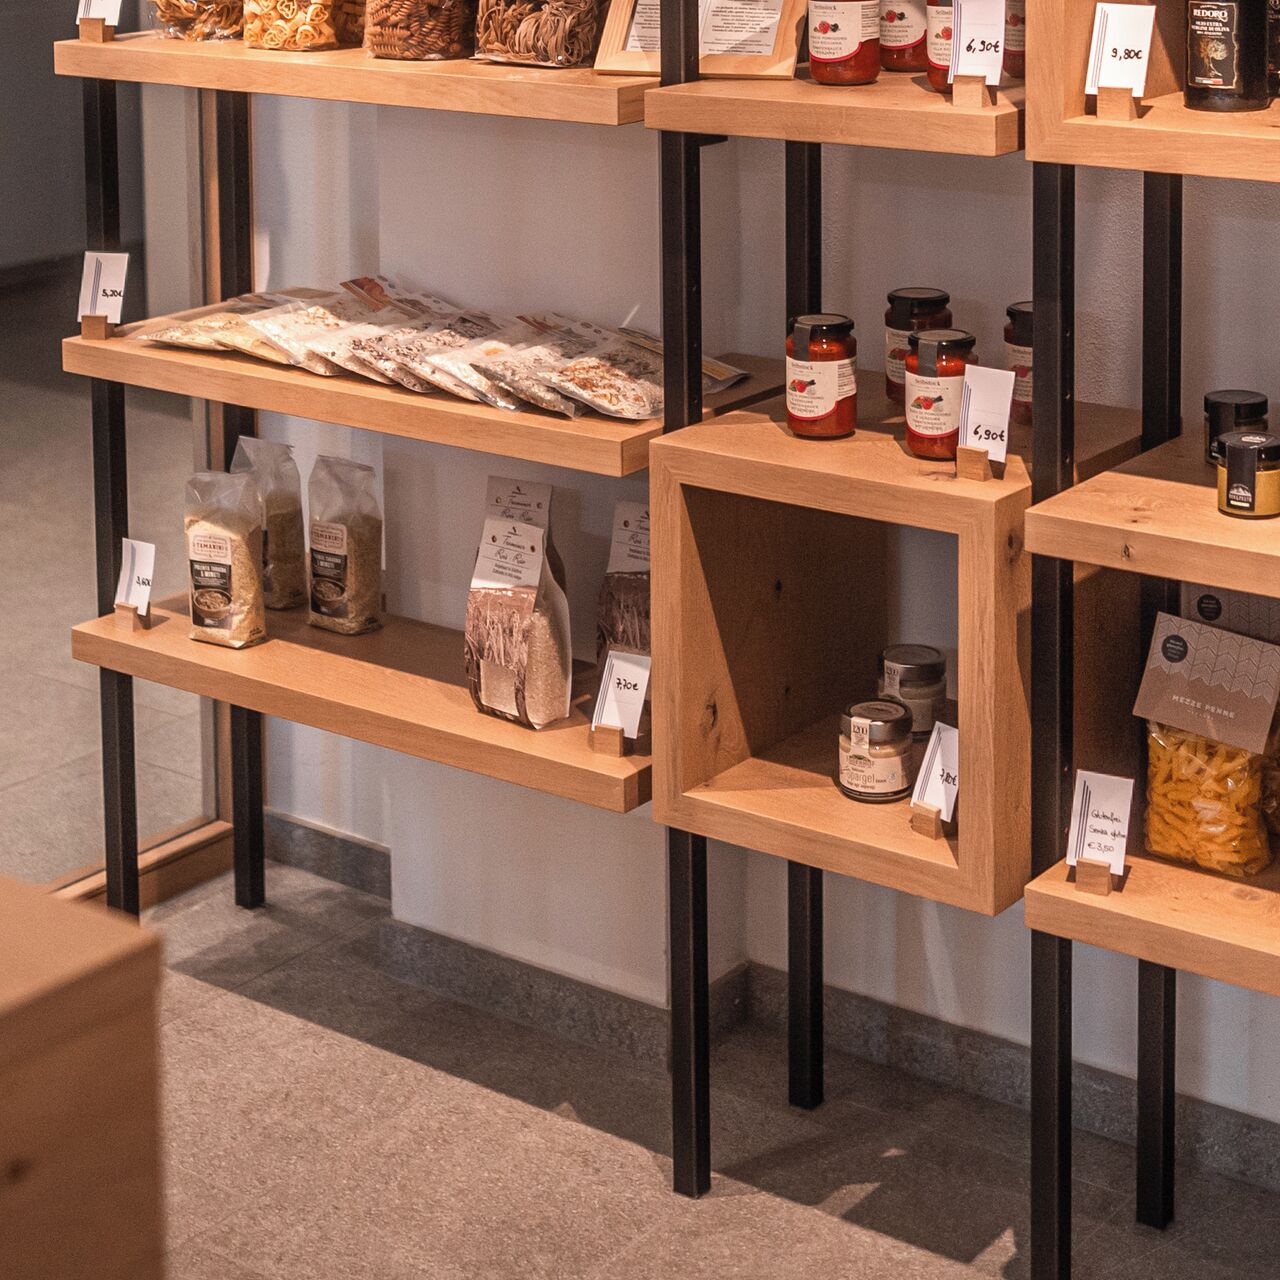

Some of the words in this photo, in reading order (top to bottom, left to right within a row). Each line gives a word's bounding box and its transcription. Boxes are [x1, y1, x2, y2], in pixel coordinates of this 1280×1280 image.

[1193, 9, 1228, 22] REDORO
[966, 39, 999, 53] 6,90€
[973, 424, 1005, 441] 6,90€
[1172, 695, 1202, 709] MEZZE
[1205, 704, 1236, 719] PENNE
[1097, 841, 1115, 854] 3,50
